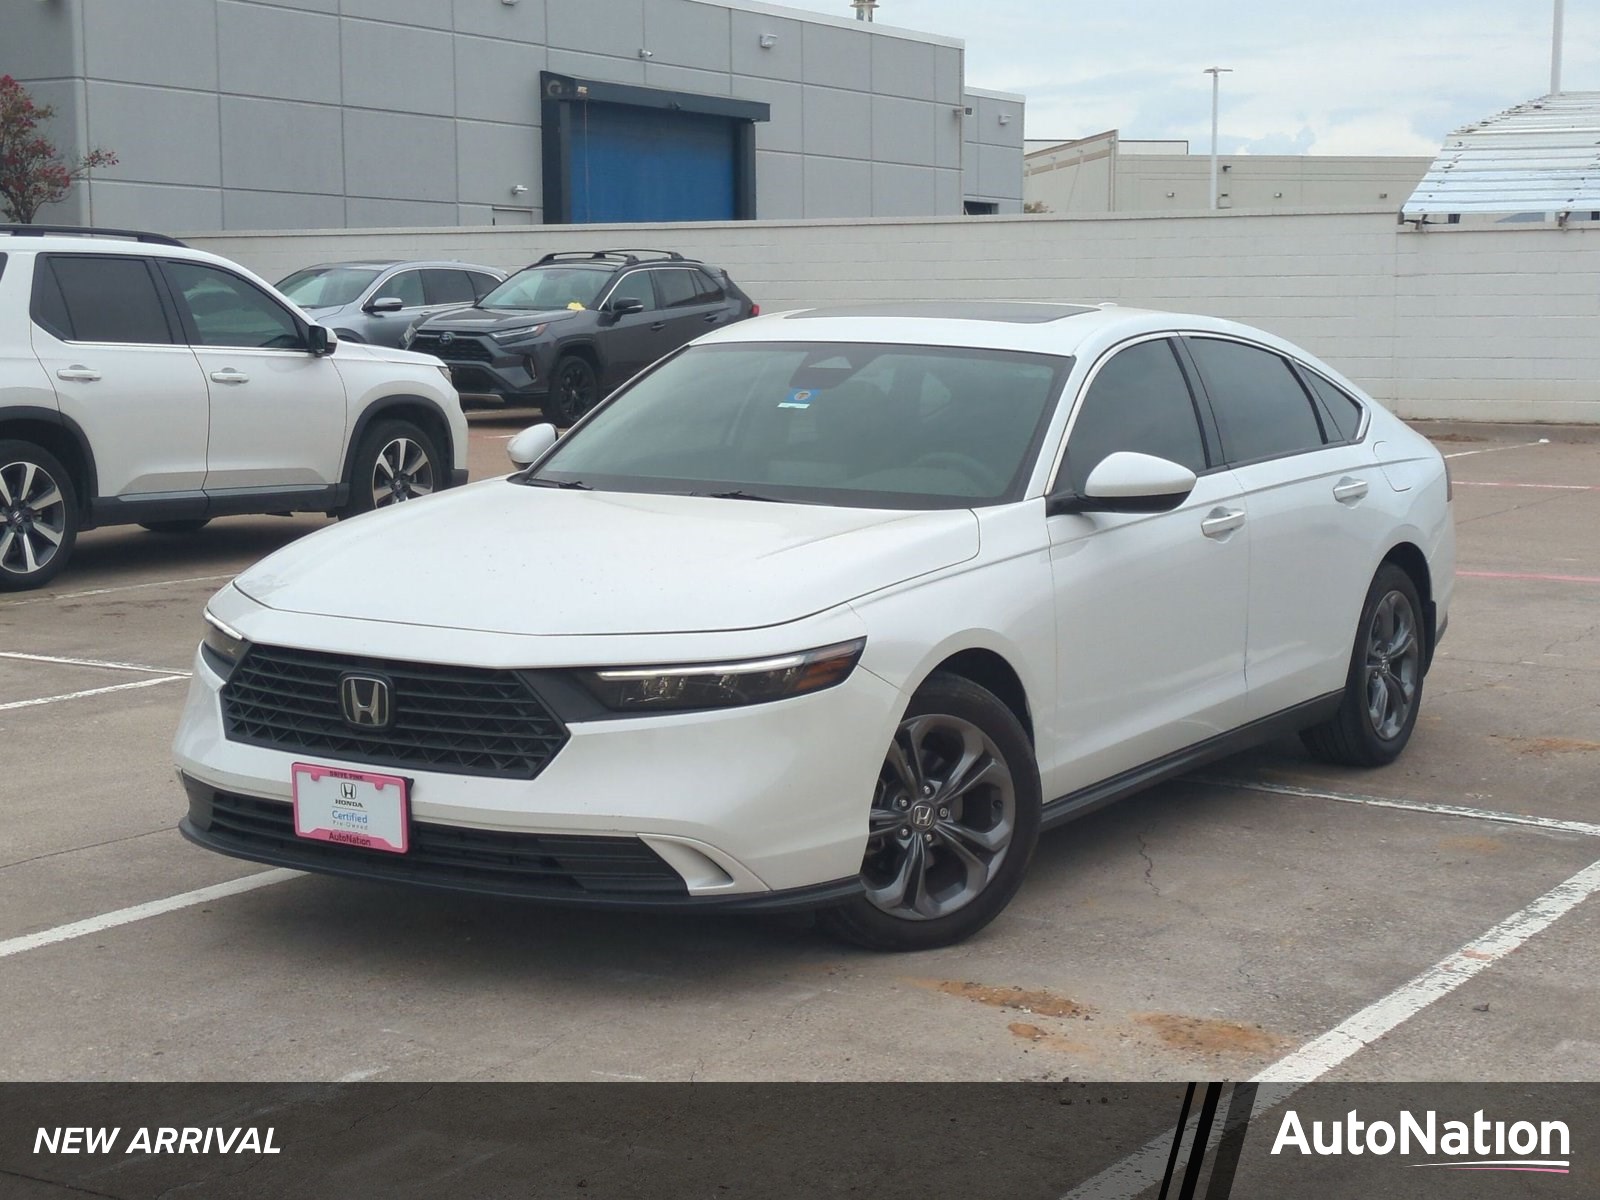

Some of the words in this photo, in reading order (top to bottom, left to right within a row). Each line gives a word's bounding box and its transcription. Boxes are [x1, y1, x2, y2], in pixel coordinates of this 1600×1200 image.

[335, 799, 364, 808] HONDA
[332, 810, 368, 824] Certified
[328, 831, 371, 846] AutoNation
